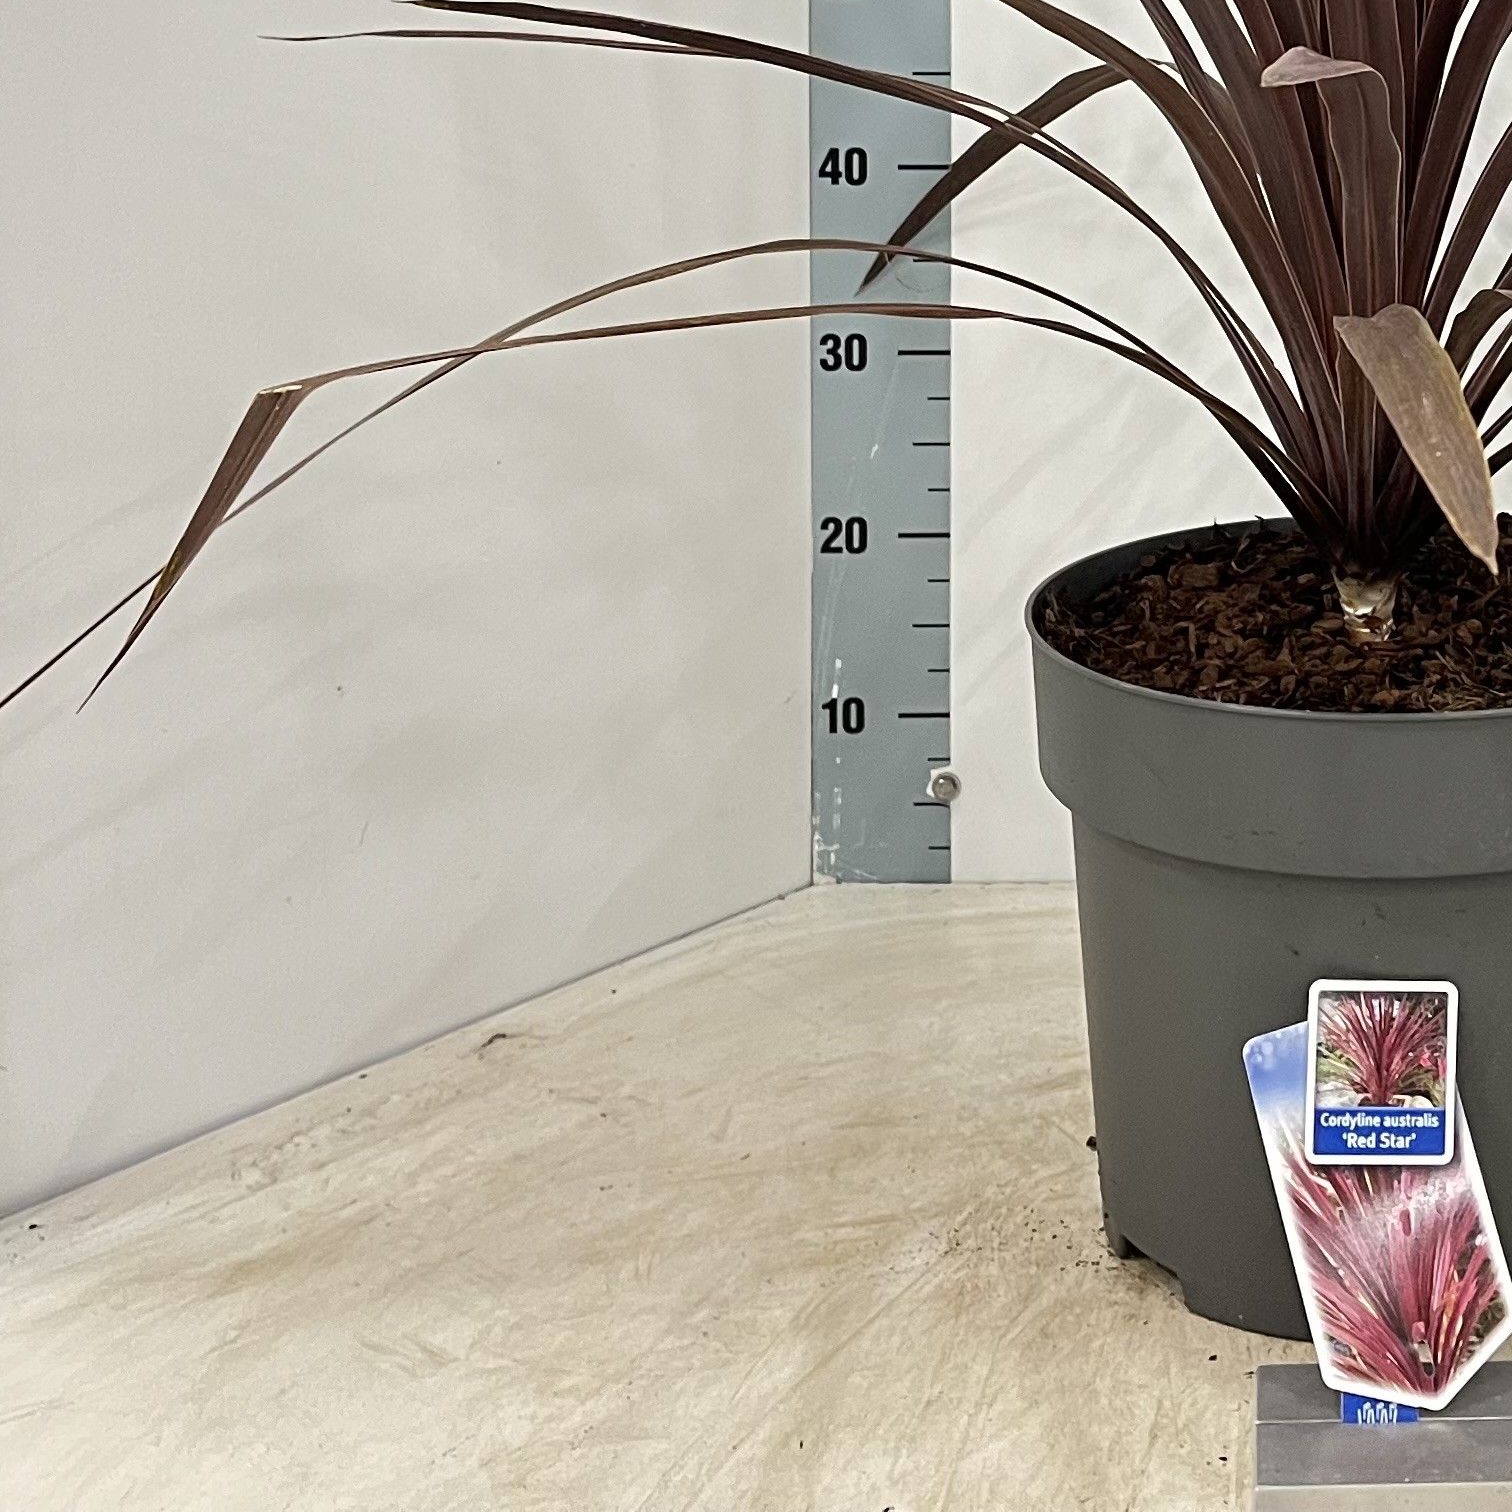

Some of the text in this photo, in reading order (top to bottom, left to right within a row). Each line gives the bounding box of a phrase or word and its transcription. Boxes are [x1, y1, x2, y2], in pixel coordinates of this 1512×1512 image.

[818, 147, 868, 186] 40
[819, 333, 868, 372] 30
[820, 516, 868, 554] 20
[821, 696, 866, 734] 10
[1320, 1112, 1440, 1130] Cordyline australis
